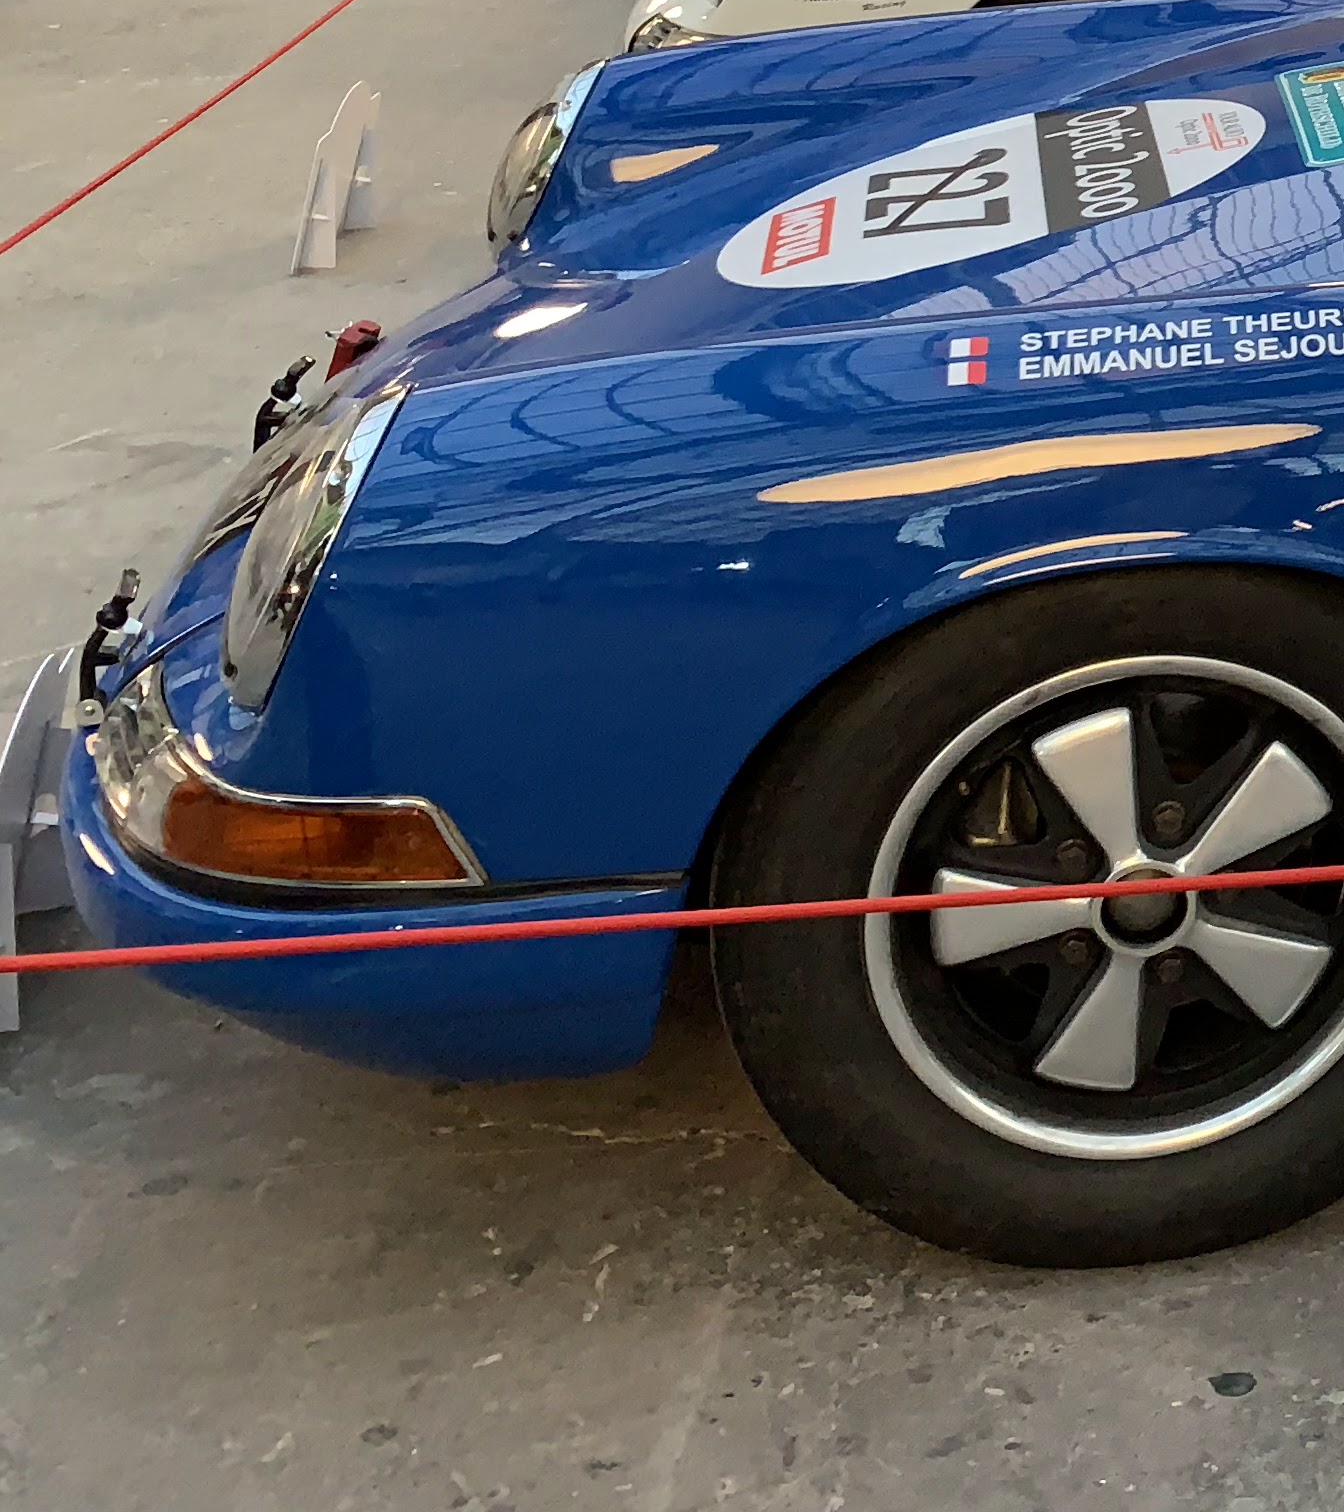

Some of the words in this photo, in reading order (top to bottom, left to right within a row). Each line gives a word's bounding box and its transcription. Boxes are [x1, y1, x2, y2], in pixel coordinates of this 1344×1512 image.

[1044, 105, 1144, 160] Optic
[863, 147, 1011, 239] 227
[1074, 150, 1150, 218] 2000
[771, 203, 826, 269] MOTUL
[1018, 342, 1225, 381] EMMANUEL
[1019, 317, 1213, 352] STEPHANE
